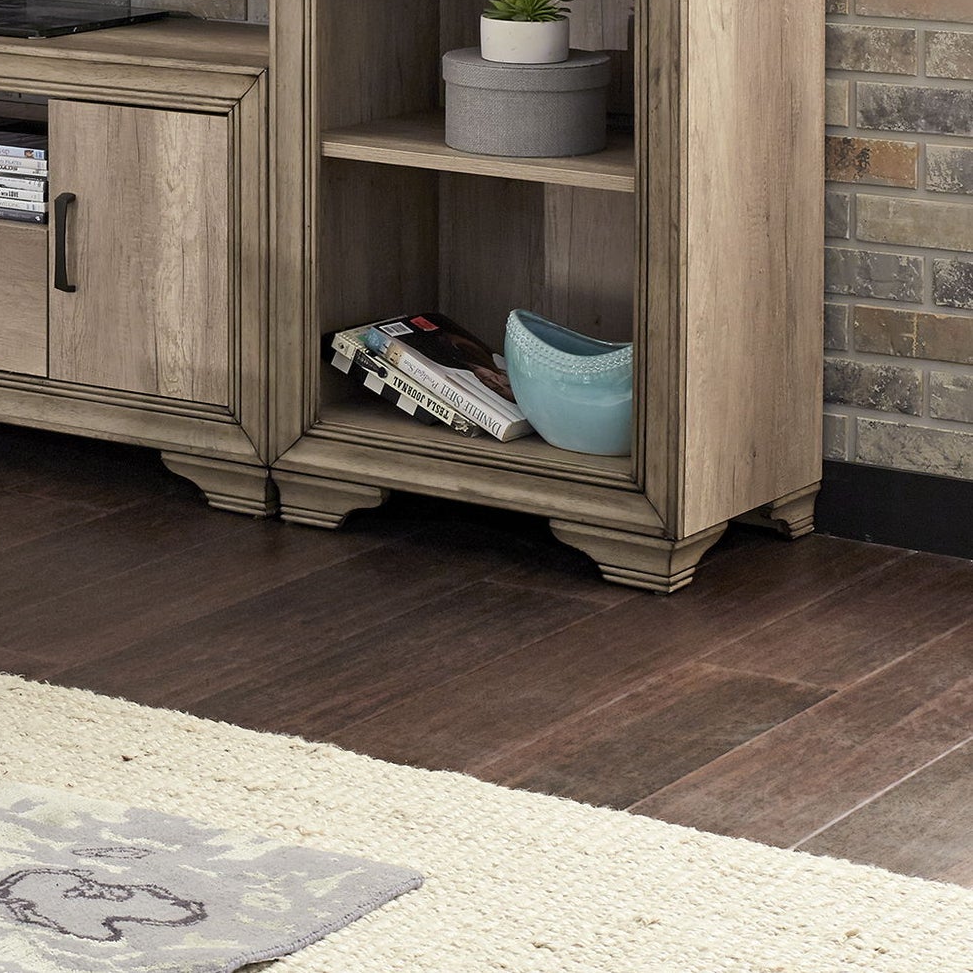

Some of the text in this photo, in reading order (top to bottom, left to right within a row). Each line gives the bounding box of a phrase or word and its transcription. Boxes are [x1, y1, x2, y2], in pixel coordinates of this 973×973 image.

[392, 375, 450, 421] TESLA JOURNAL
[464, 401, 501, 436] DANIELLE
